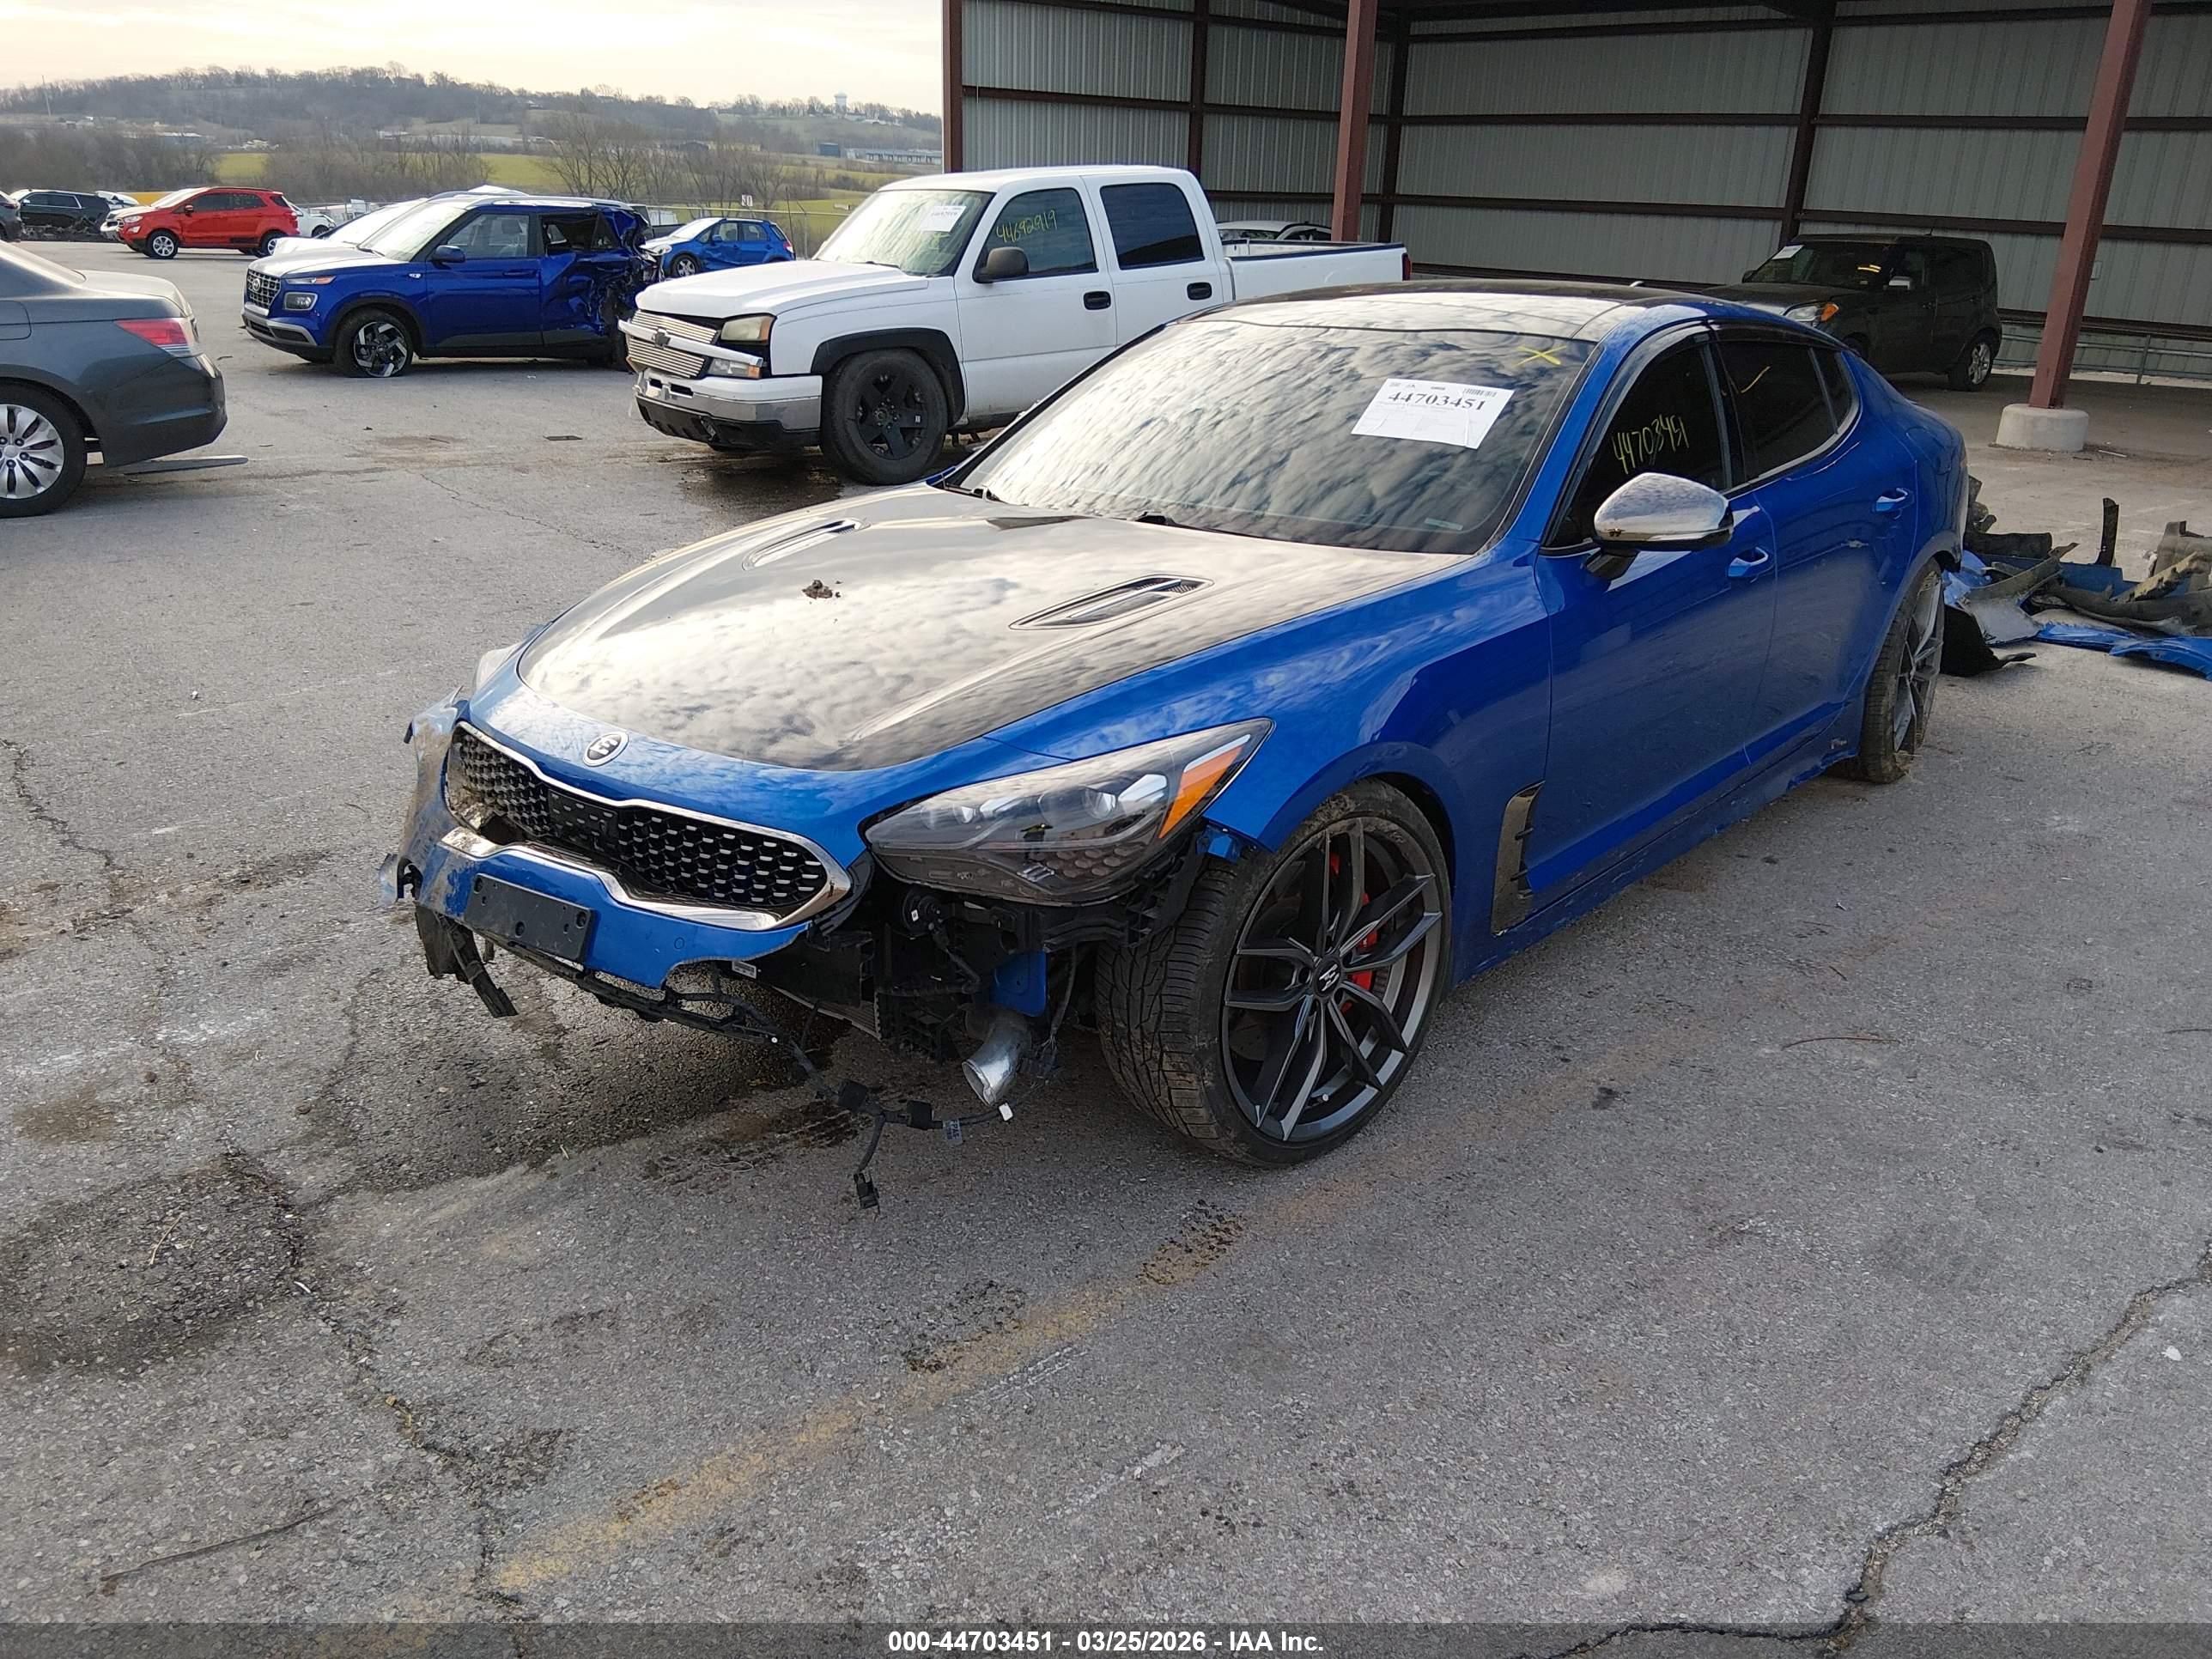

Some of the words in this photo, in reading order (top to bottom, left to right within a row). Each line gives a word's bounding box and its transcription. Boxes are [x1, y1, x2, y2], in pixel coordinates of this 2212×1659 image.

[995, 209, 1058, 243] 44692919
[1388, 391, 1486, 410] 44703451
[1611, 414, 1690, 475] 44703451
